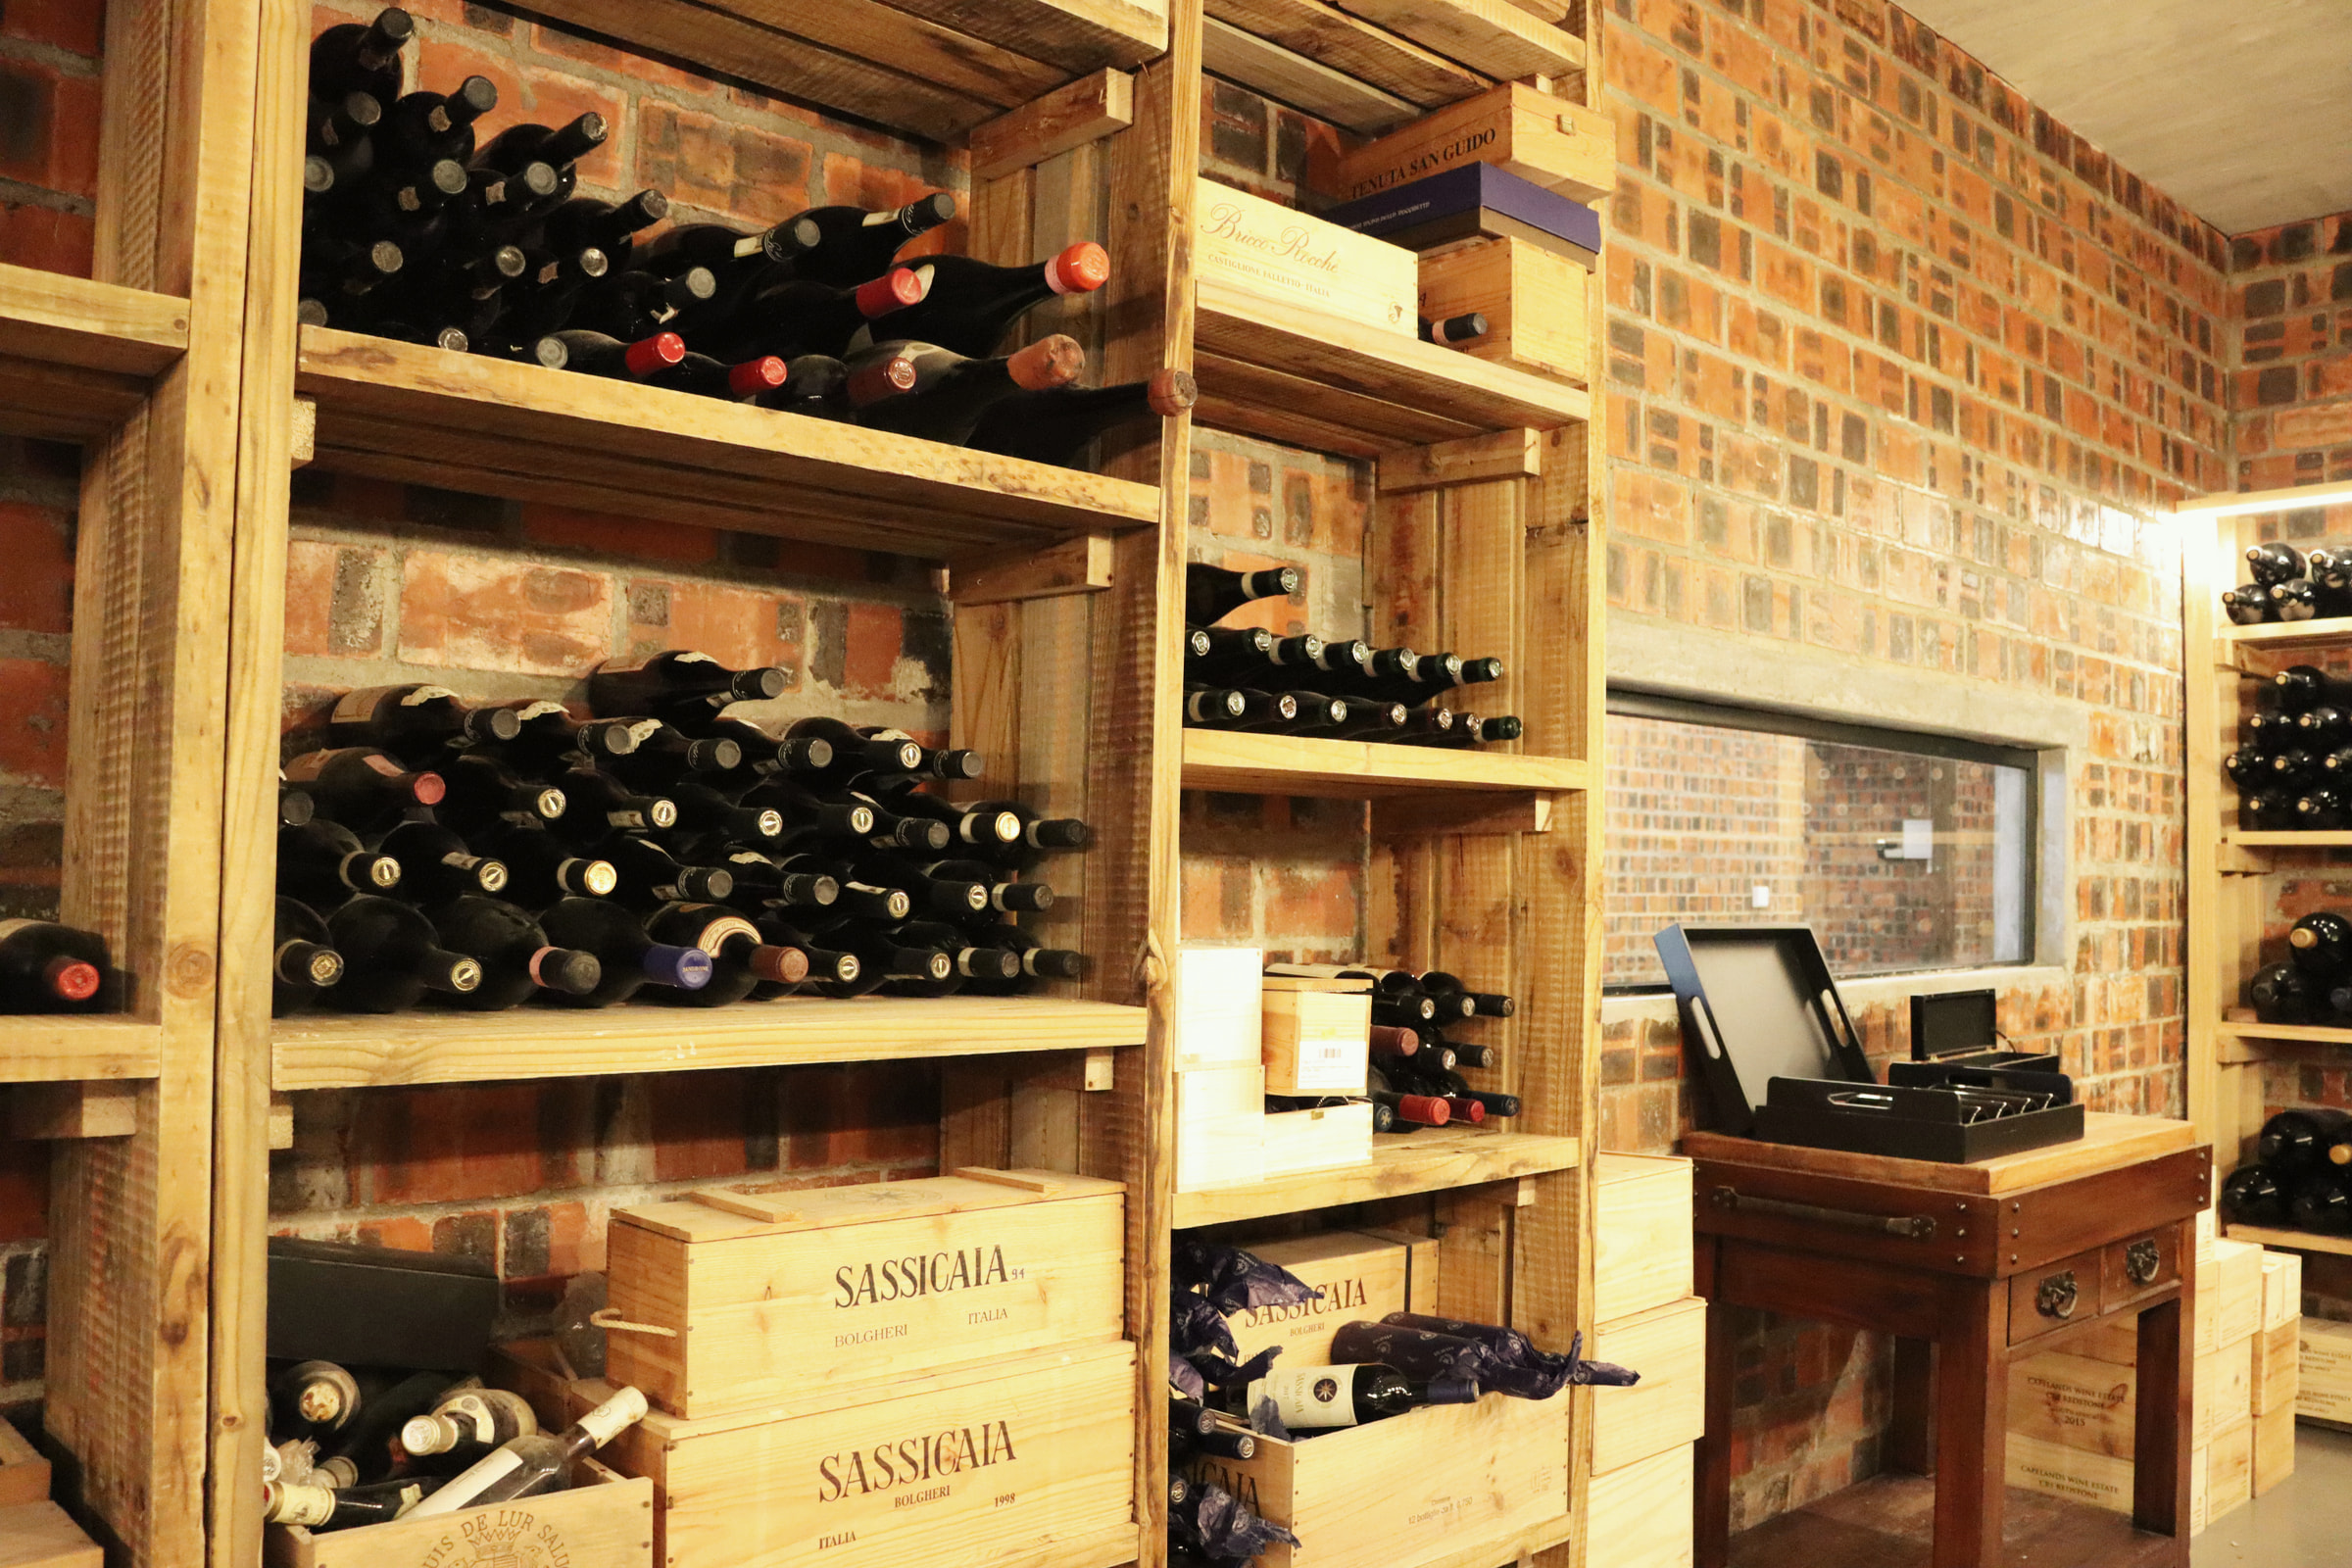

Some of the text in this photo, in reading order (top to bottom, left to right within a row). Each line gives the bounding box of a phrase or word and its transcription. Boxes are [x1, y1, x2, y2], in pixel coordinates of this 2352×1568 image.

[1349, 127, 1496, 199] TENUTA SAN GUIDO
[1200, 203, 1268, 251] Bricco
[1208, 253, 1331, 298] CASTIGLIONE FALLETTO ITALIA
[835, 1244, 1025, 1308] SASSICAIA 94
[835, 1307, 1008, 1348] BOLGHERI ITALIA
[1290, 1322, 1325, 1337] BOLGHERI
[819, 1420, 1017, 1503] SASSICAIA
[2067, 1476, 2088, 1488] WINE
[894, 1485, 951, 1508] BOLGHERI
[994, 1493, 1016, 1507] 1998
[461, 1513, 488, 1538] DE
[498, 1510, 534, 1532] LUR
[537, 1523, 570, 1568] SALU
[818, 1531, 857, 1549] ITALIA
